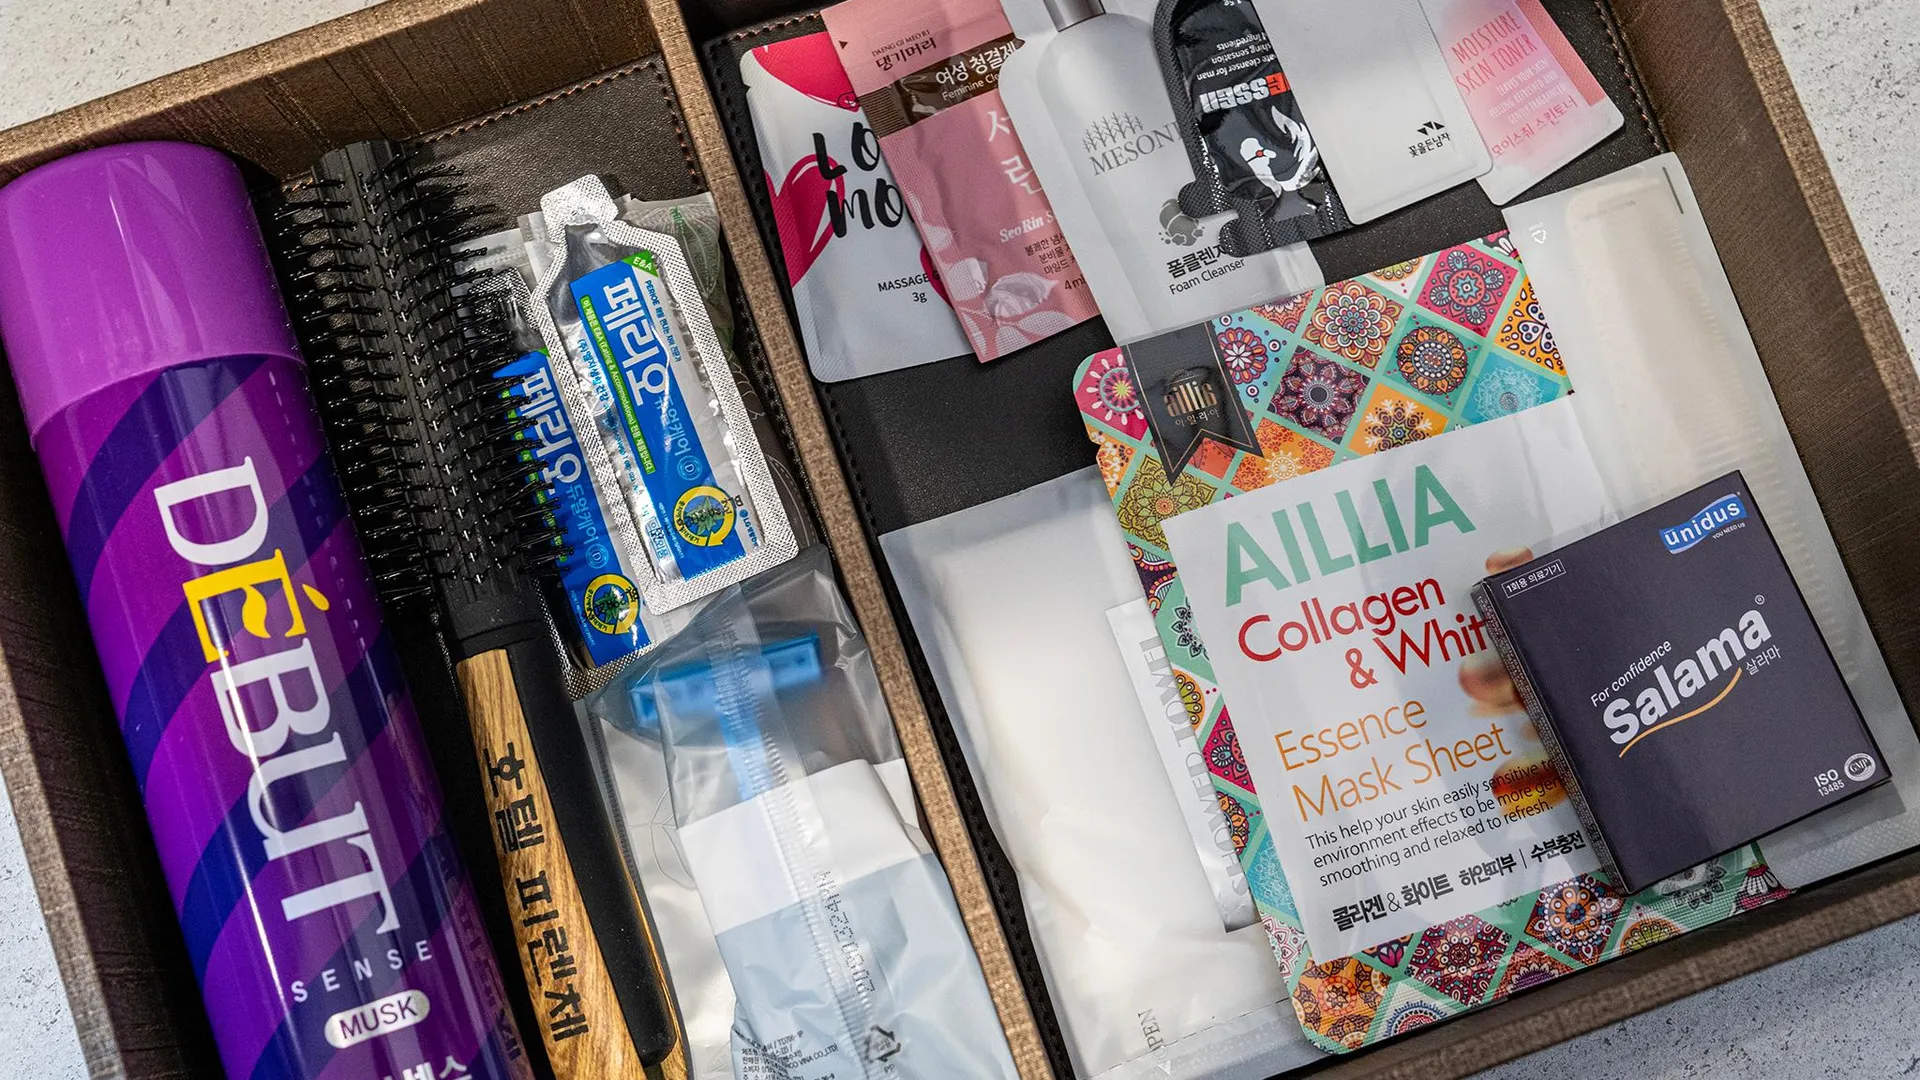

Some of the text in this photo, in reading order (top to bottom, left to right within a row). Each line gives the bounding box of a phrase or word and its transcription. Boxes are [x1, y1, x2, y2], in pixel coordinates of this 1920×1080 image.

[871, 45, 896, 57] DAENG
[875, 37, 937, 71] 댕기머리
[1211, 47, 1250, 65] sensation
[1217, 34, 1262, 51] ingredients
[1451, 10, 1522, 64] MOISTURE
[935, 61, 967, 86] 여성
[1196, 70, 1215, 81] man
[1215, 64, 1229, 77] for
[1228, 56, 1262, 73] cleanser
[1456, 33, 1537, 95] SKIN TONER
[942, 78, 985, 101] Feminine
[1535, 94, 1579, 130] 스킨토너
[1408, 131, 1451, 158] 꽃을든남자
[632, 255, 653, 271] E&A
[877, 272, 929, 293] MASSAGE
[1169, 257, 1246, 296] Foam Cleanser
[645, 279, 661, 306] PERIOE
[911, 290, 928, 304] 3g
[602, 276, 668, 407] 페리오
[564, 485, 600, 546] 듀얼케어
[1225, 464, 1477, 608] AILLIA
[1505, 562, 1563, 595] 1회용 의료기기
[1238, 577, 1446, 662] Collagen
[1344, 647, 1379, 690] &
[1373, 612, 1489, 675] Whit
[1745, 643, 1782, 677] 살라마
[1590, 639, 1673, 707] For confidence
[1602, 608, 1773, 745] Salama
[1274, 699, 1428, 772] Essence
[1291, 722, 1512, 823] Mask Sheet
[1813, 767, 1846, 798] ISO 13485
[1304, 829, 1338, 851] This
[1339, 817, 1374, 843] help
[1374, 807, 1409, 834] your
[1410, 794, 1442, 816] skin
[1443, 780, 1481, 807] easily
[1481, 764, 1537, 790] sensitive
[1312, 827, 1409, 869] environment
[1409, 808, 1459, 836] effects
[1459, 802, 1476, 820] to
[1476, 795, 1496, 815] be
[1496, 785, 1535, 808] more
[1319, 801, 1555, 888] smoothing and relaxed to refresh.
[483, 742, 590, 1042] 호텔 피렌체
[1331, 892, 1389, 933] 콜라겐
[1400, 872, 1455, 907] 화이트
[1529, 828, 1587, 864] 수분충전
[290, 939, 433, 1003] SENSE
[338, 995, 419, 1041] MUSK
